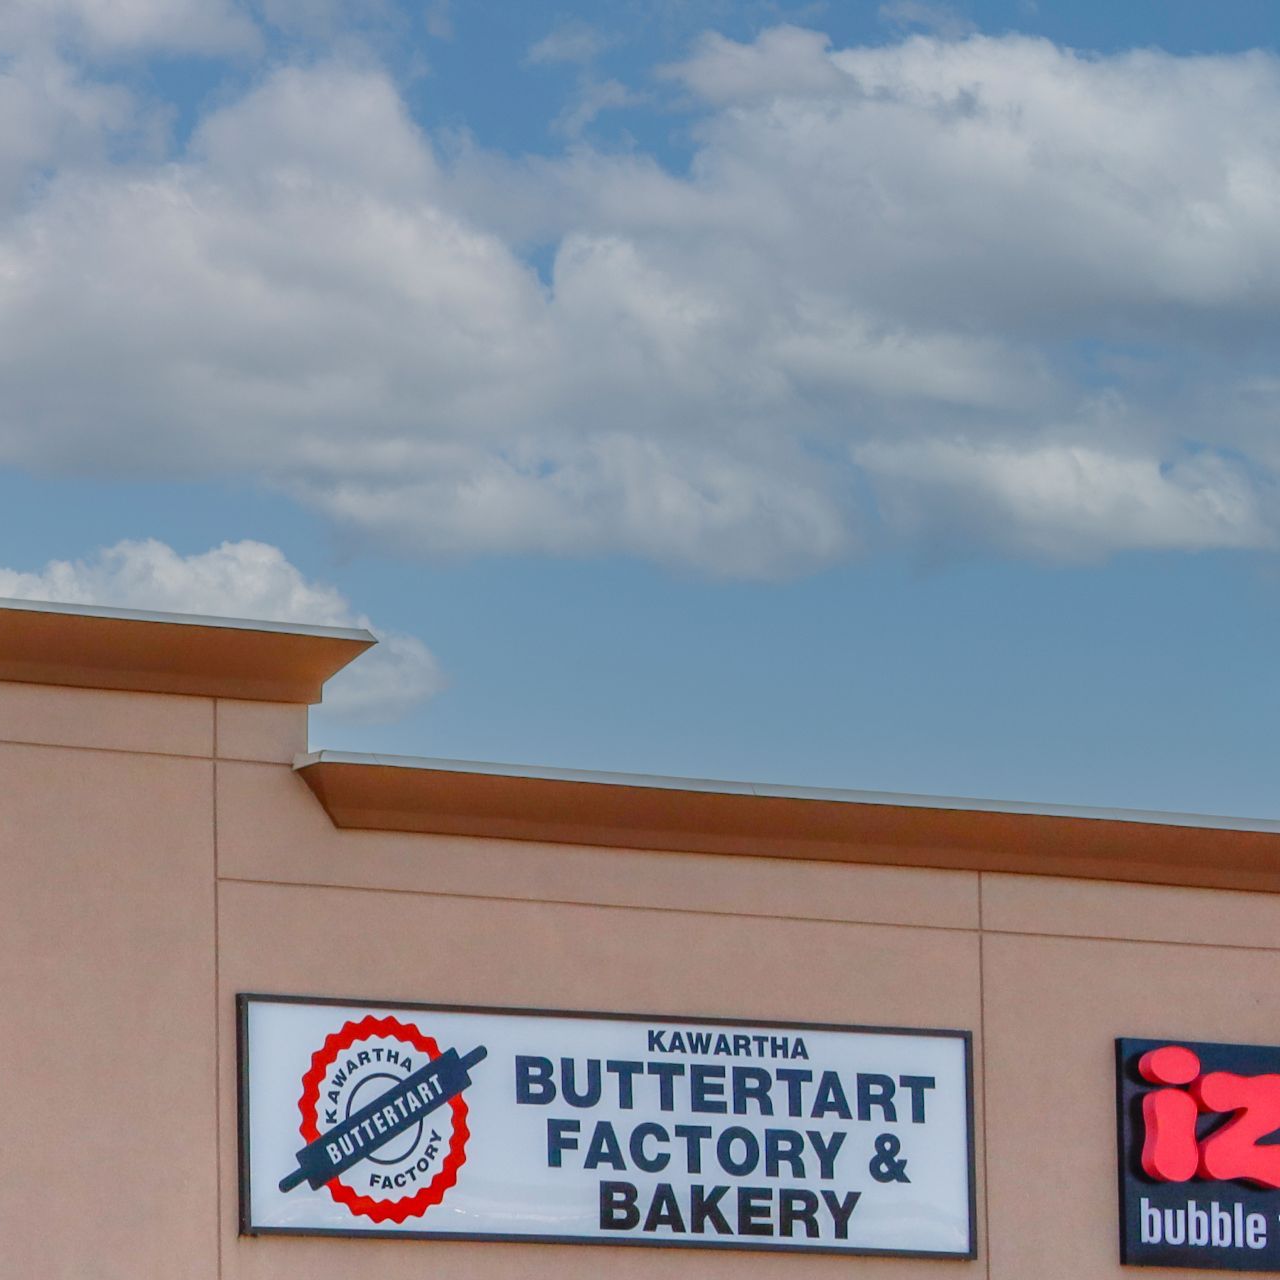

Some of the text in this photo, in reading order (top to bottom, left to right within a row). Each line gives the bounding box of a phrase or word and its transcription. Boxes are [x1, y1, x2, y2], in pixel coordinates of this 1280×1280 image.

[648, 1030, 809, 1060] KAWARTHA
[325, 1047, 413, 1125] KAWARTHA
[515, 1055, 935, 1124] BUTTERTART
[325, 1074, 445, 1166] BUTTERTART
[547, 1118, 911, 1183] FACTORY &
[369, 1128, 443, 1190] FACTORY
[599, 1180, 862, 1240] BAKERY
[1140, 1198, 1268, 1249] bubble
